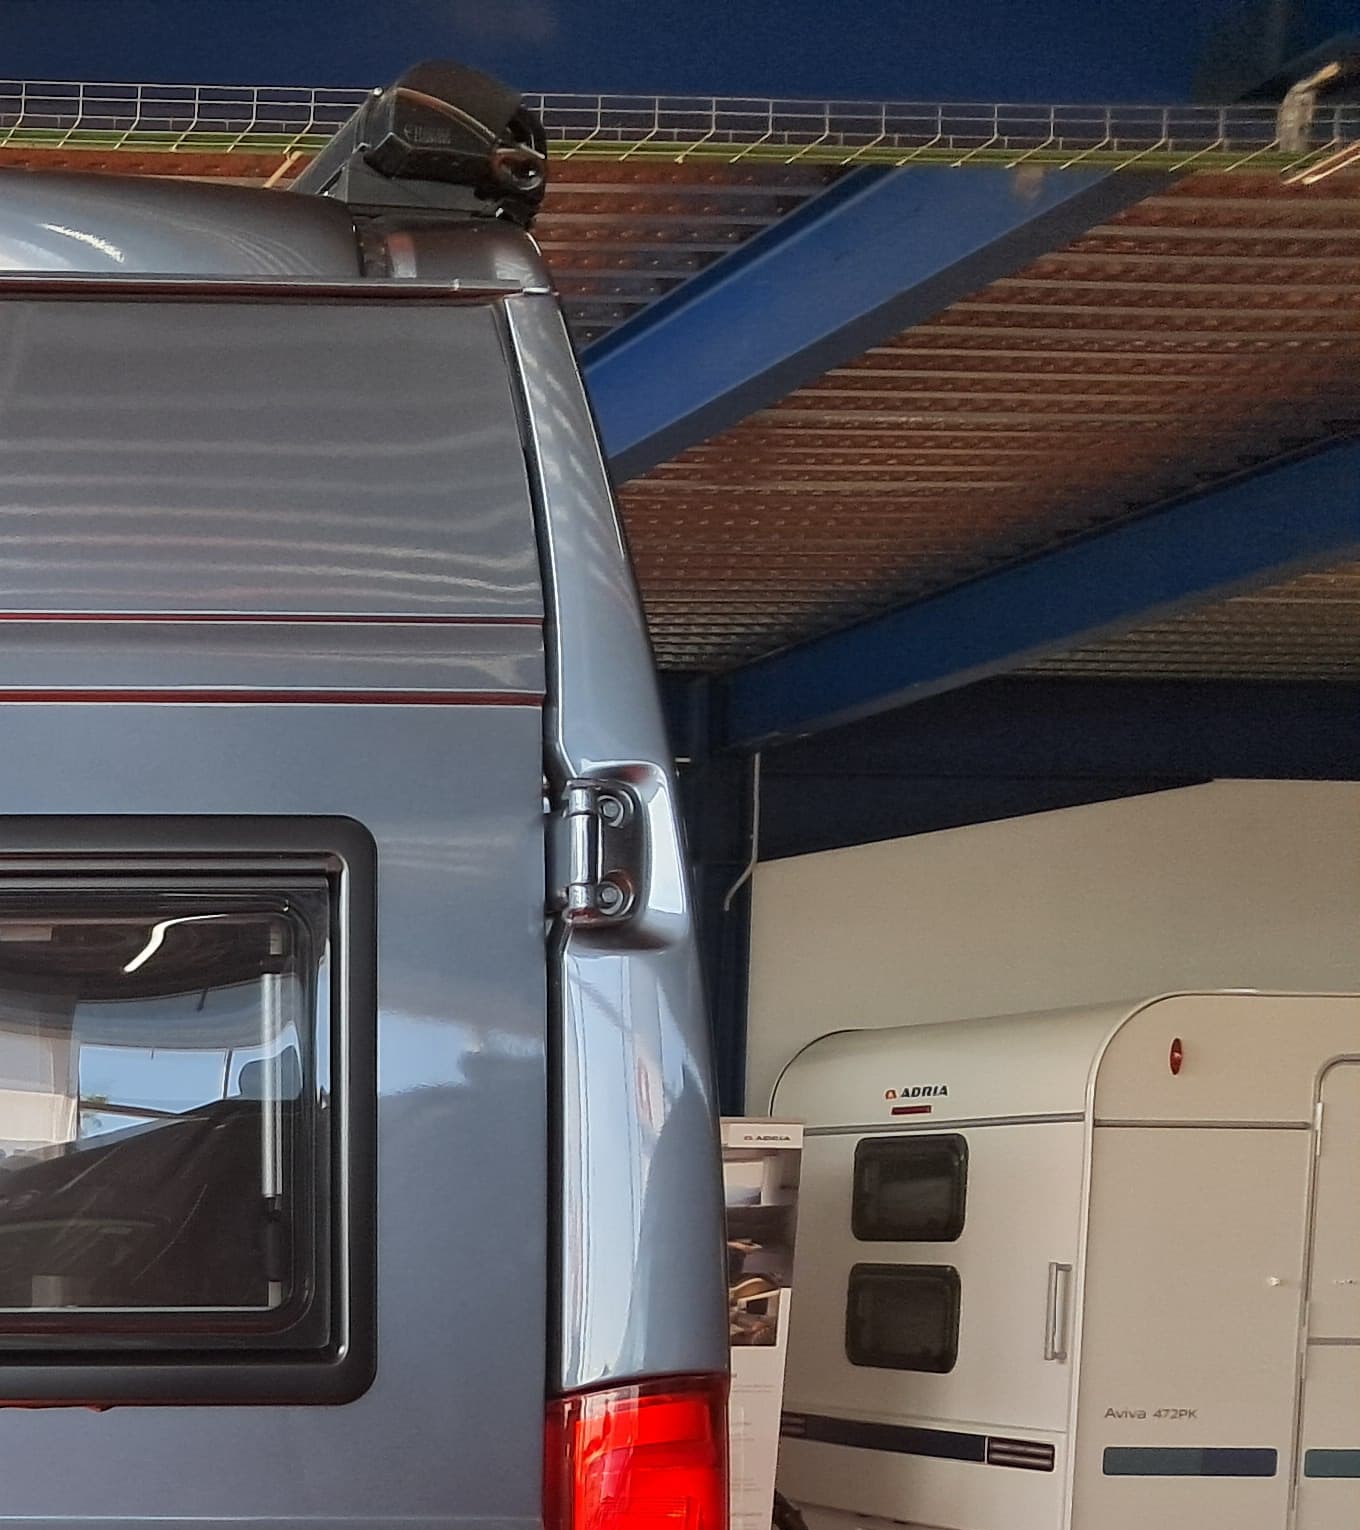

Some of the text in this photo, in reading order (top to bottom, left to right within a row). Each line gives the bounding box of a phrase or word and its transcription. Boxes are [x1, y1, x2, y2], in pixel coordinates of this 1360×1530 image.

[899, 1084, 949, 1099] ADRIA
[1104, 1407, 1199, 1420] Aviva 472PK
